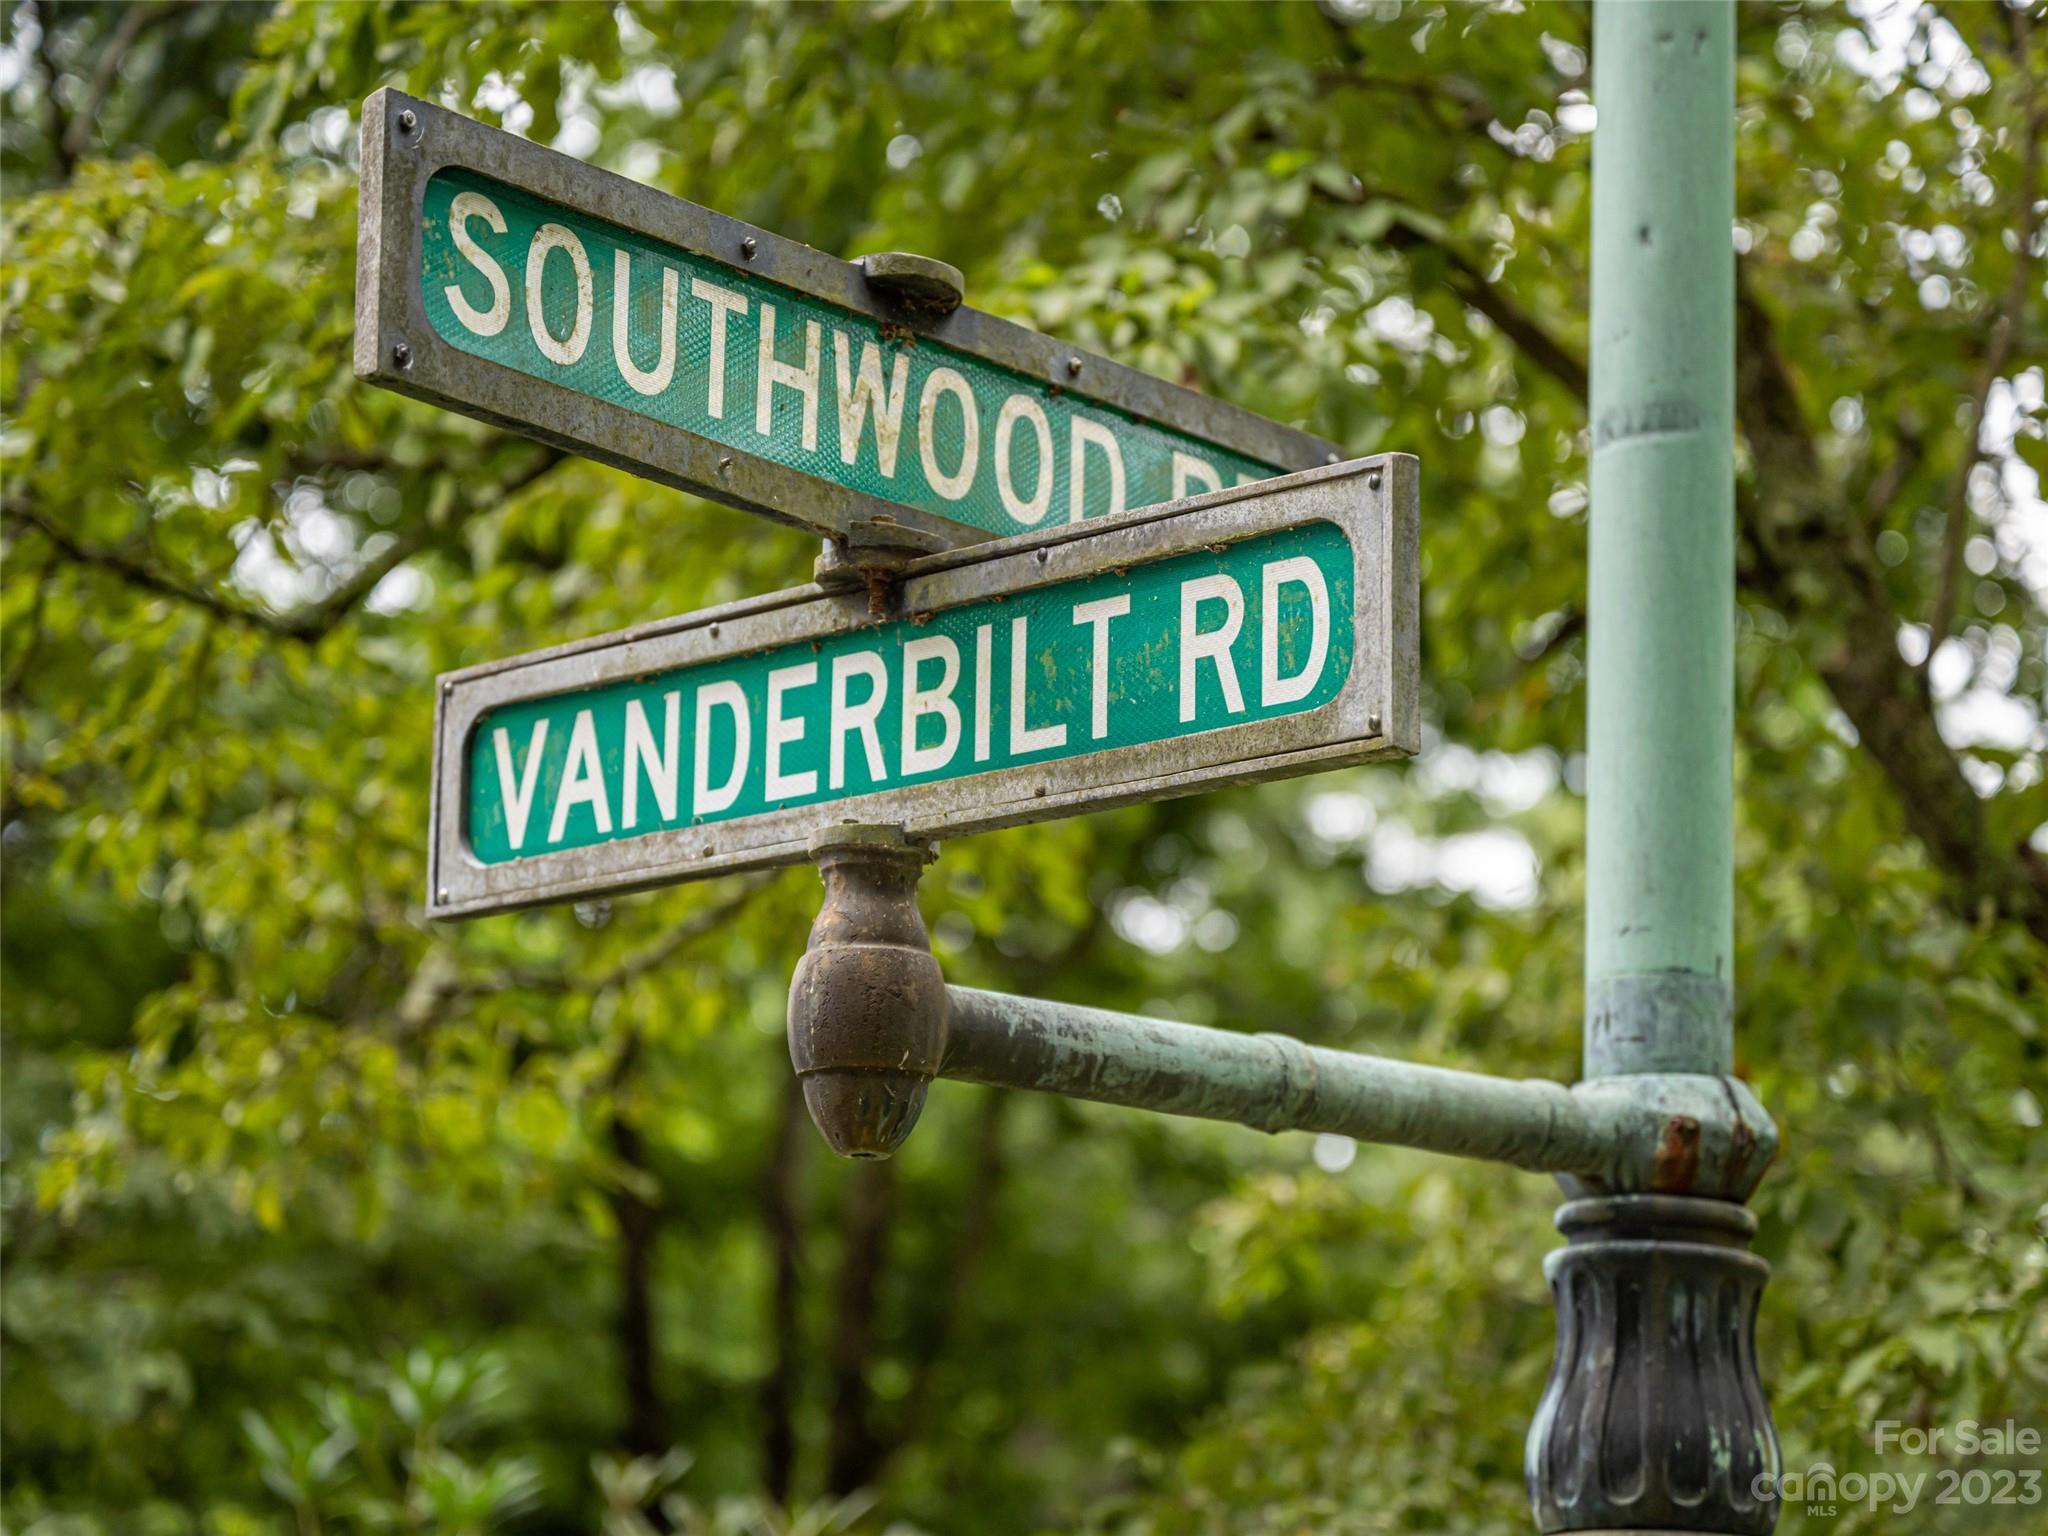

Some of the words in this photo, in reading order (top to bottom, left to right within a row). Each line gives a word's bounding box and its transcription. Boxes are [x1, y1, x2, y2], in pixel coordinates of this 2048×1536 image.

[444, 191, 1126, 525] SOUTHWOOD
[492, 594, 1131, 850] VANDERBILT
[1179, 556, 1332, 723] RD
